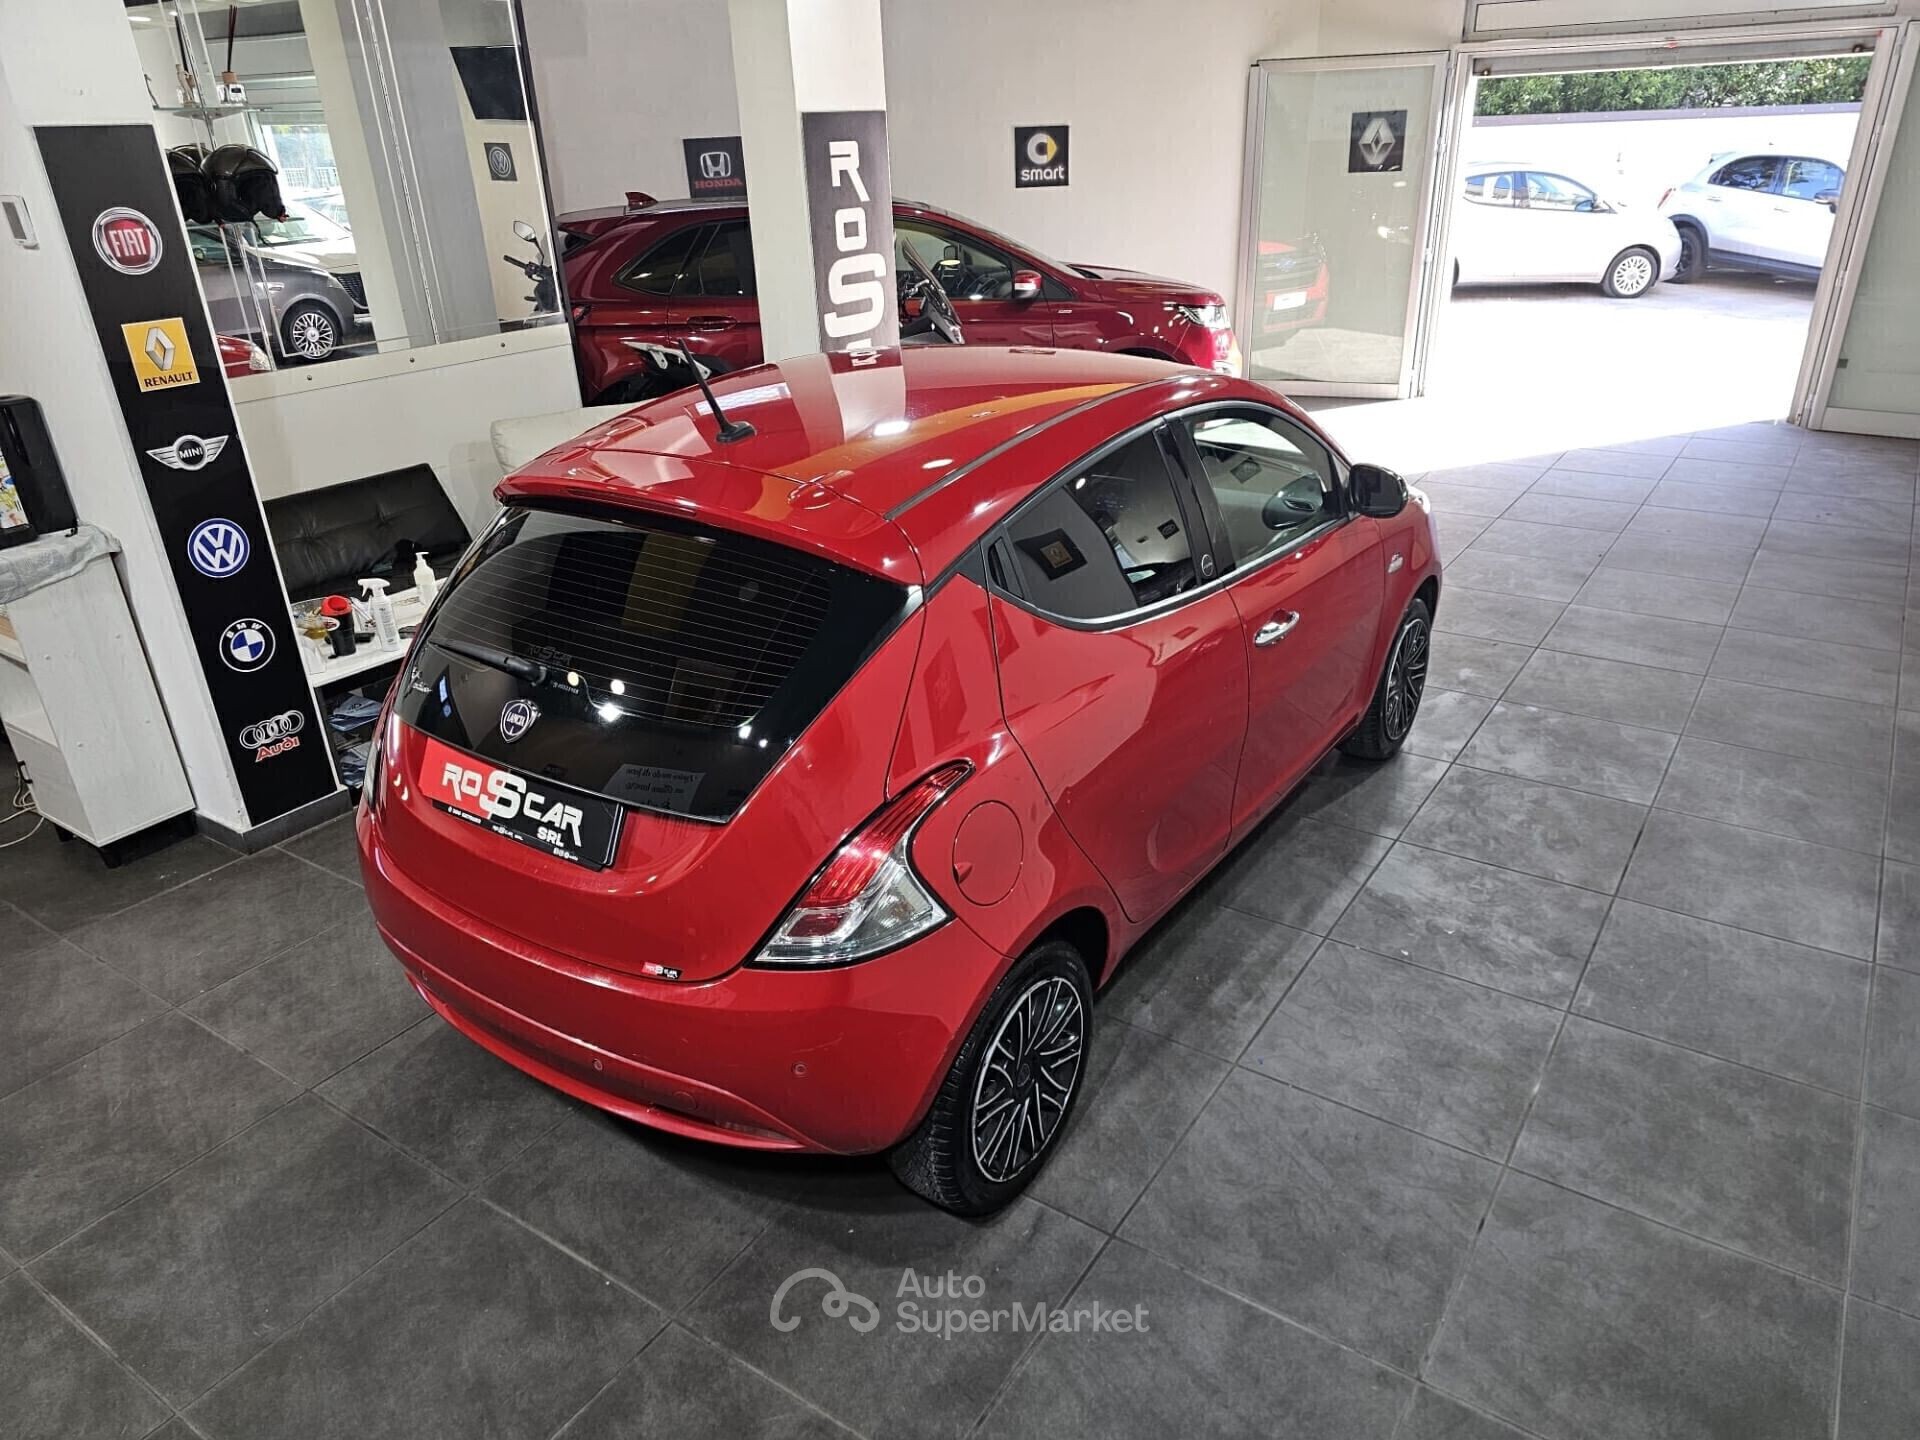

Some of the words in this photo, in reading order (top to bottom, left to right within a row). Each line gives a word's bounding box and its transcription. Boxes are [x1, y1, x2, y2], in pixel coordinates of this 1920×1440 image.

[1021, 165, 1065, 181] smart
[694, 178, 743, 190] HONDA
[108, 227, 147, 258] FIAT
[143, 371, 193, 388] RENAULT
[178, 447, 204, 460] MINI
[226, 622, 263, 639] BMW
[255, 735, 301, 762] Audi
[536, 826, 565, 848] SRL
